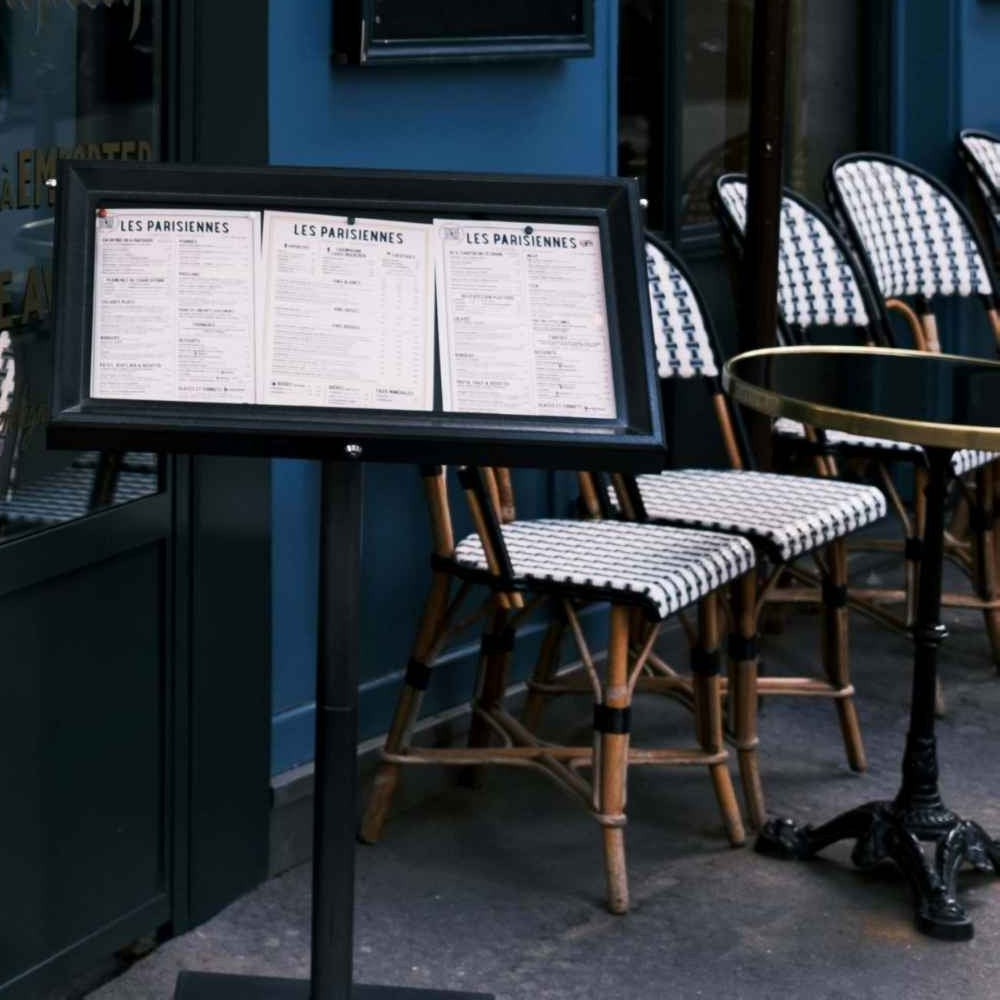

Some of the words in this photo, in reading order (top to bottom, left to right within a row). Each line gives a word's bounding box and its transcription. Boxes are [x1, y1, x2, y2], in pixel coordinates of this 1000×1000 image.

[120, 219, 143, 232] LES
[147, 220, 230, 234] PARISIENNES
[293, 223, 317, 237] LES
[320, 226, 404, 245] PARISIENNES
[466, 232, 489, 244] LES
[494, 233, 577, 249] PARISIENNES
